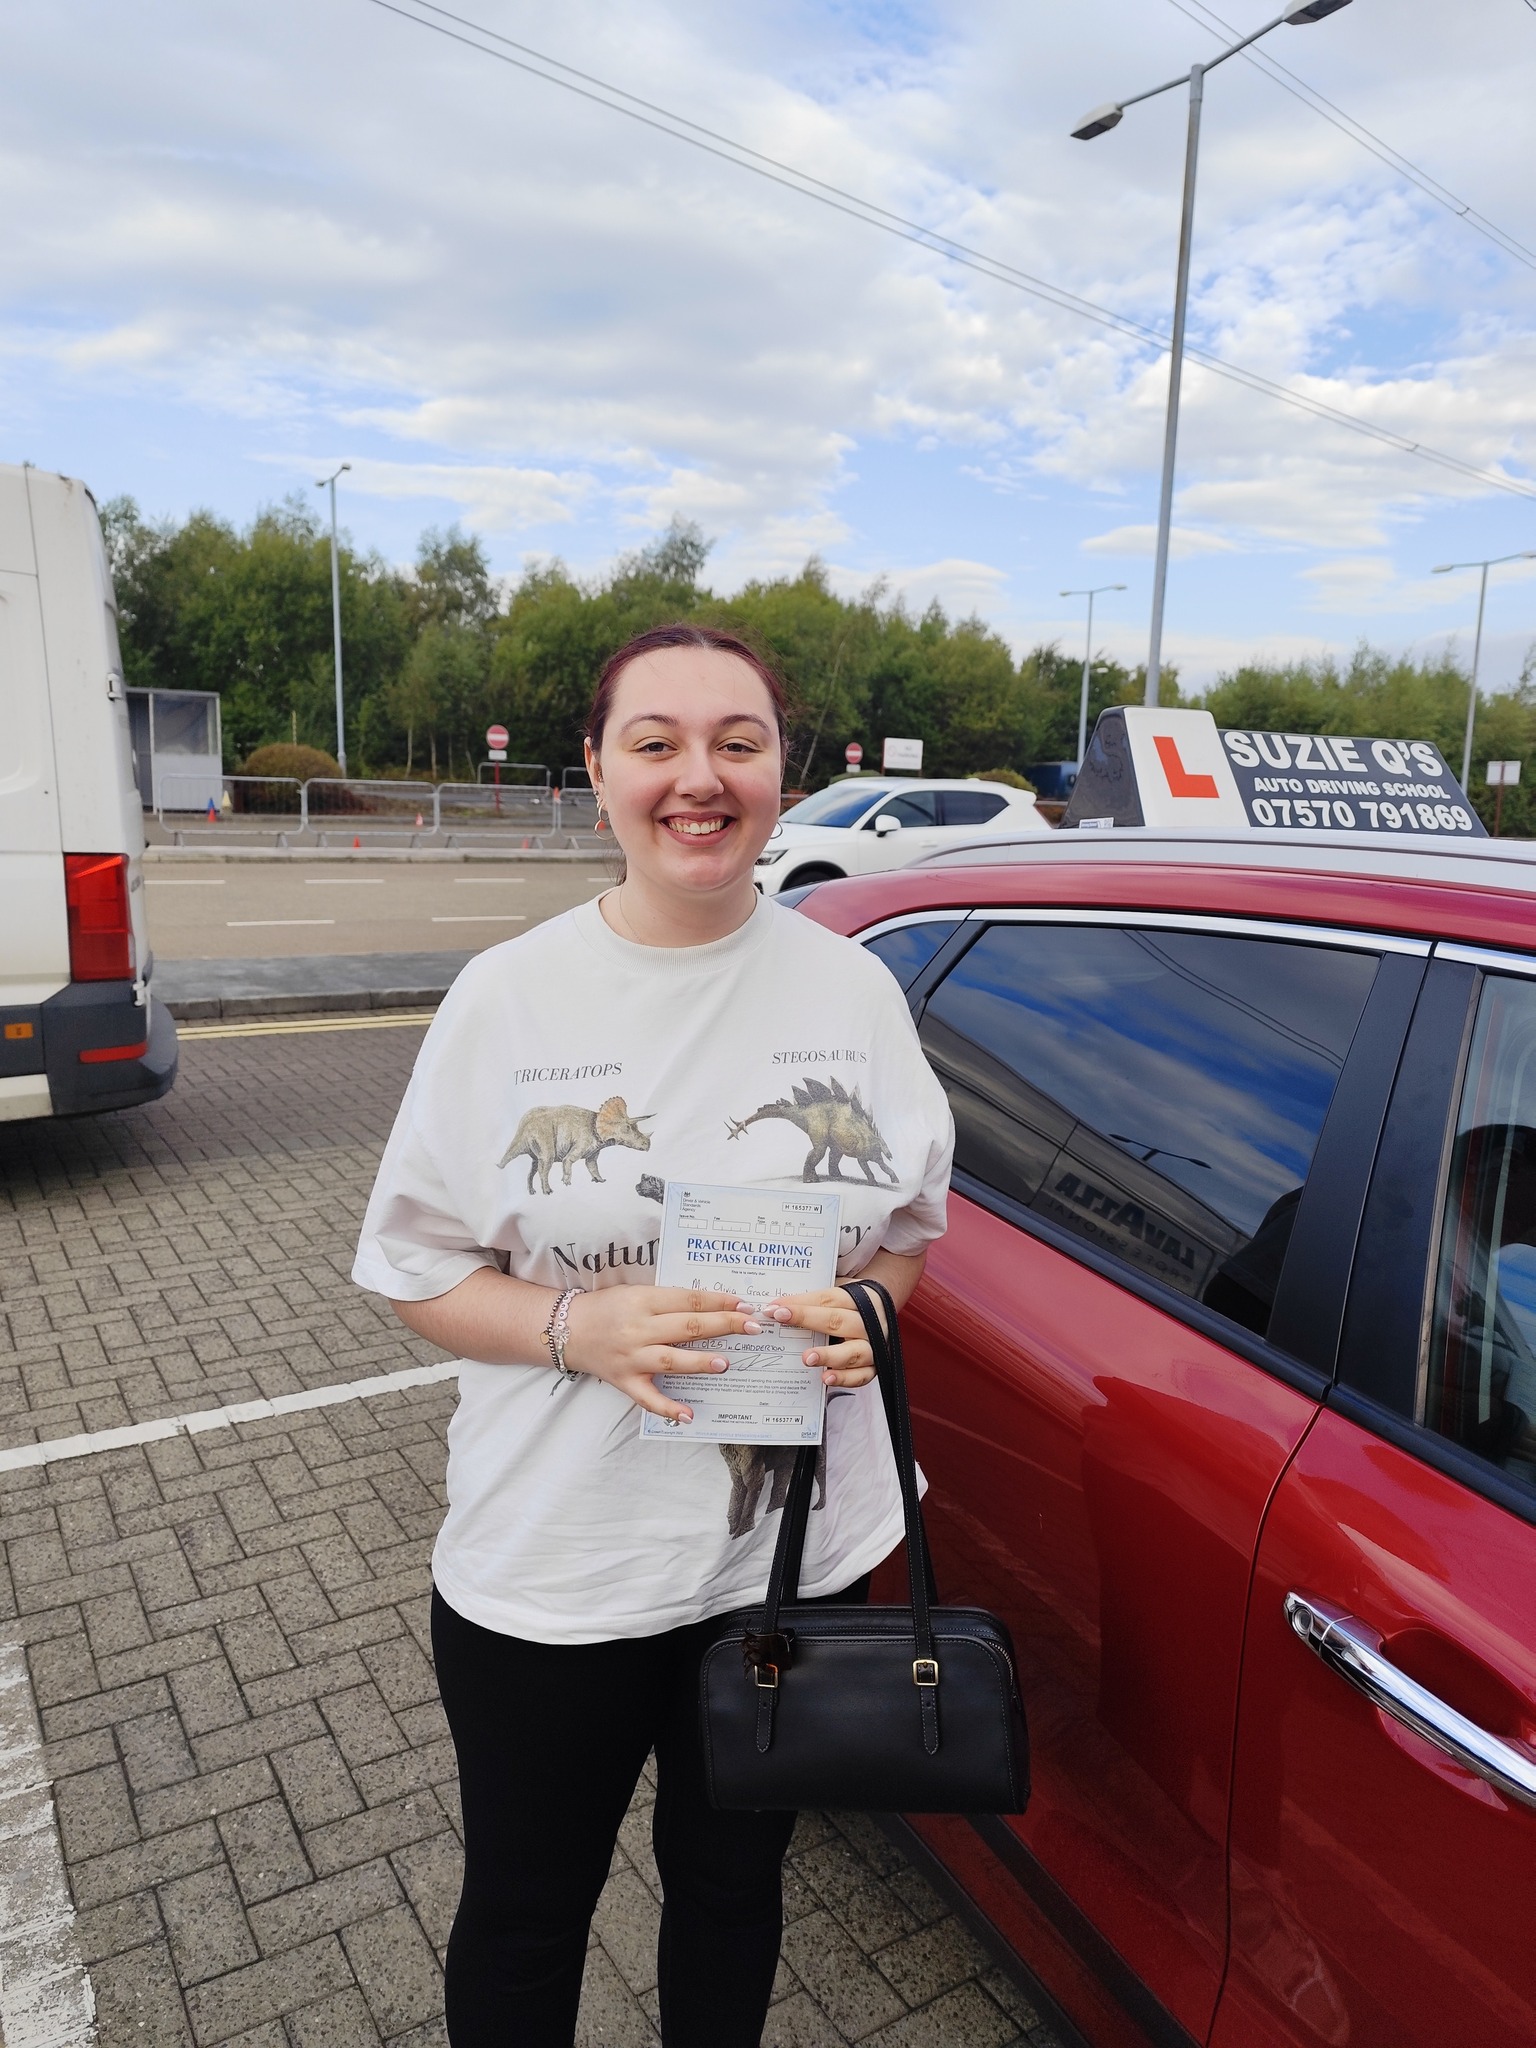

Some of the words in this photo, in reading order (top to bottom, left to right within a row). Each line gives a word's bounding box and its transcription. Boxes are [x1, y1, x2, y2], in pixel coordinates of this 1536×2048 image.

[1153, 735, 1220, 798] L
[1223, 731, 1368, 772] SUZIE
[1370, 739, 1443, 778] Q'S
[1253, 776, 1304, 794] AUTO
[1306, 778, 1381, 797] DRIVING
[1384, 782, 1451, 800] SCHOOL
[1252, 798, 1356, 828] 07570
[1359, 802, 1473, 832] 791869
[772, 1049, 867, 1065] STEGOSAURUS
[513, 1061, 623, 1086] TRICERATOPS
[550, 1237, 660, 1278] Natur
[687, 1238, 754, 1253] PRACTICAL
[758, 1242, 813, 1257] DRIVING
[686, 1251, 712, 1262] TEST
[716, 1254, 741, 1265] PASS
[744, 1255, 812, 1269] CERTIFICATE
[746, 1286, 770, 1296] Grace
